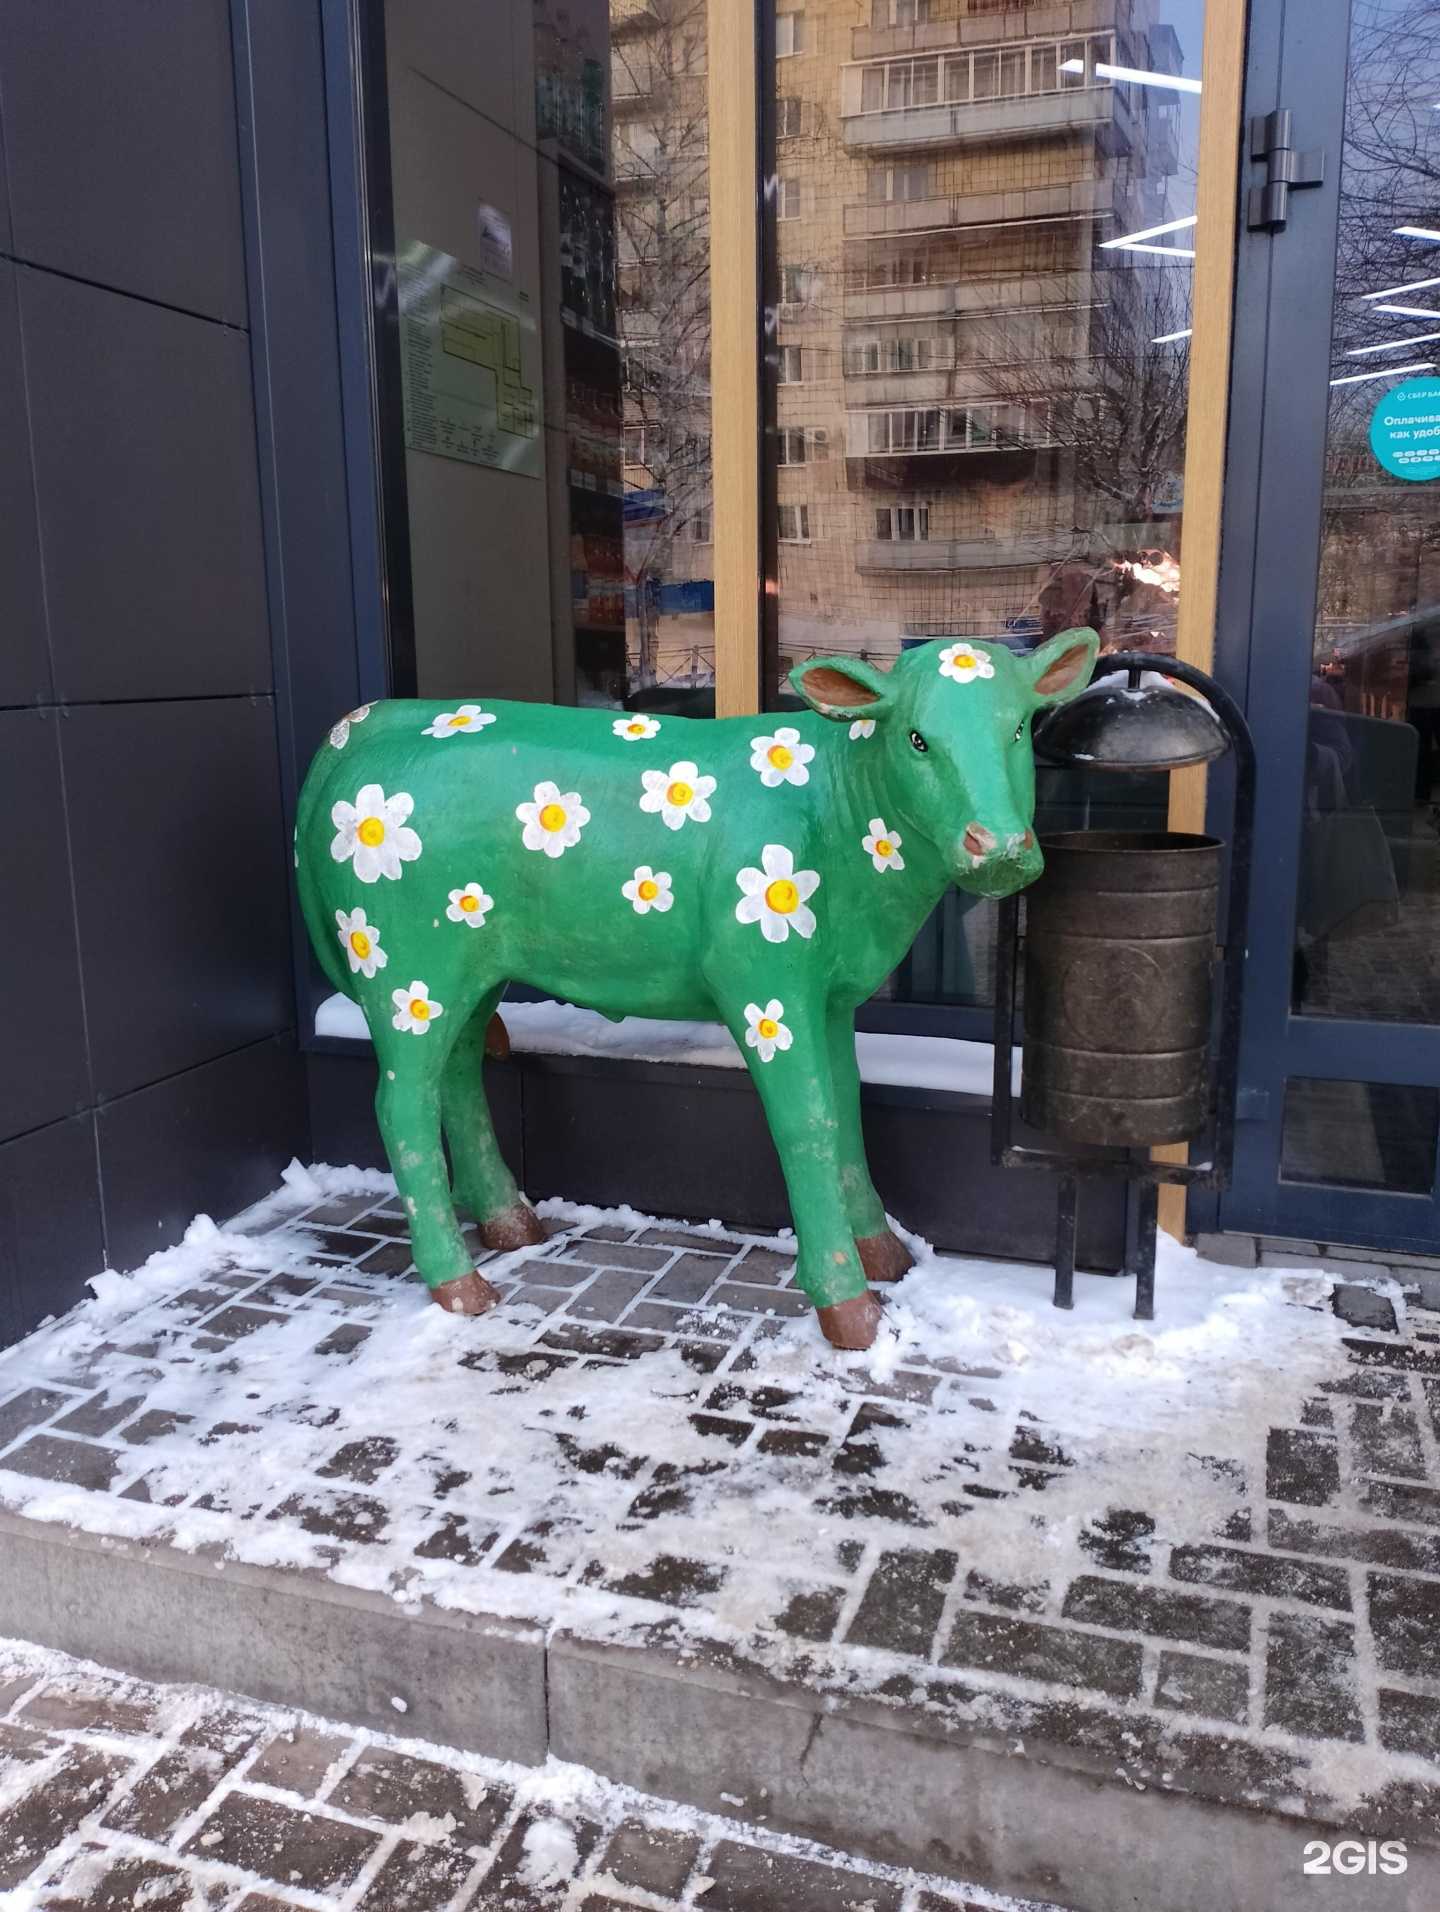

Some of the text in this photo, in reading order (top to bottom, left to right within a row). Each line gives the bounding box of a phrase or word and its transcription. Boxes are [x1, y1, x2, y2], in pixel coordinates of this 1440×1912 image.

[1407, 391, 1440, 399] СБЕРБА
[1389, 426, 1440, 439] как удоб
